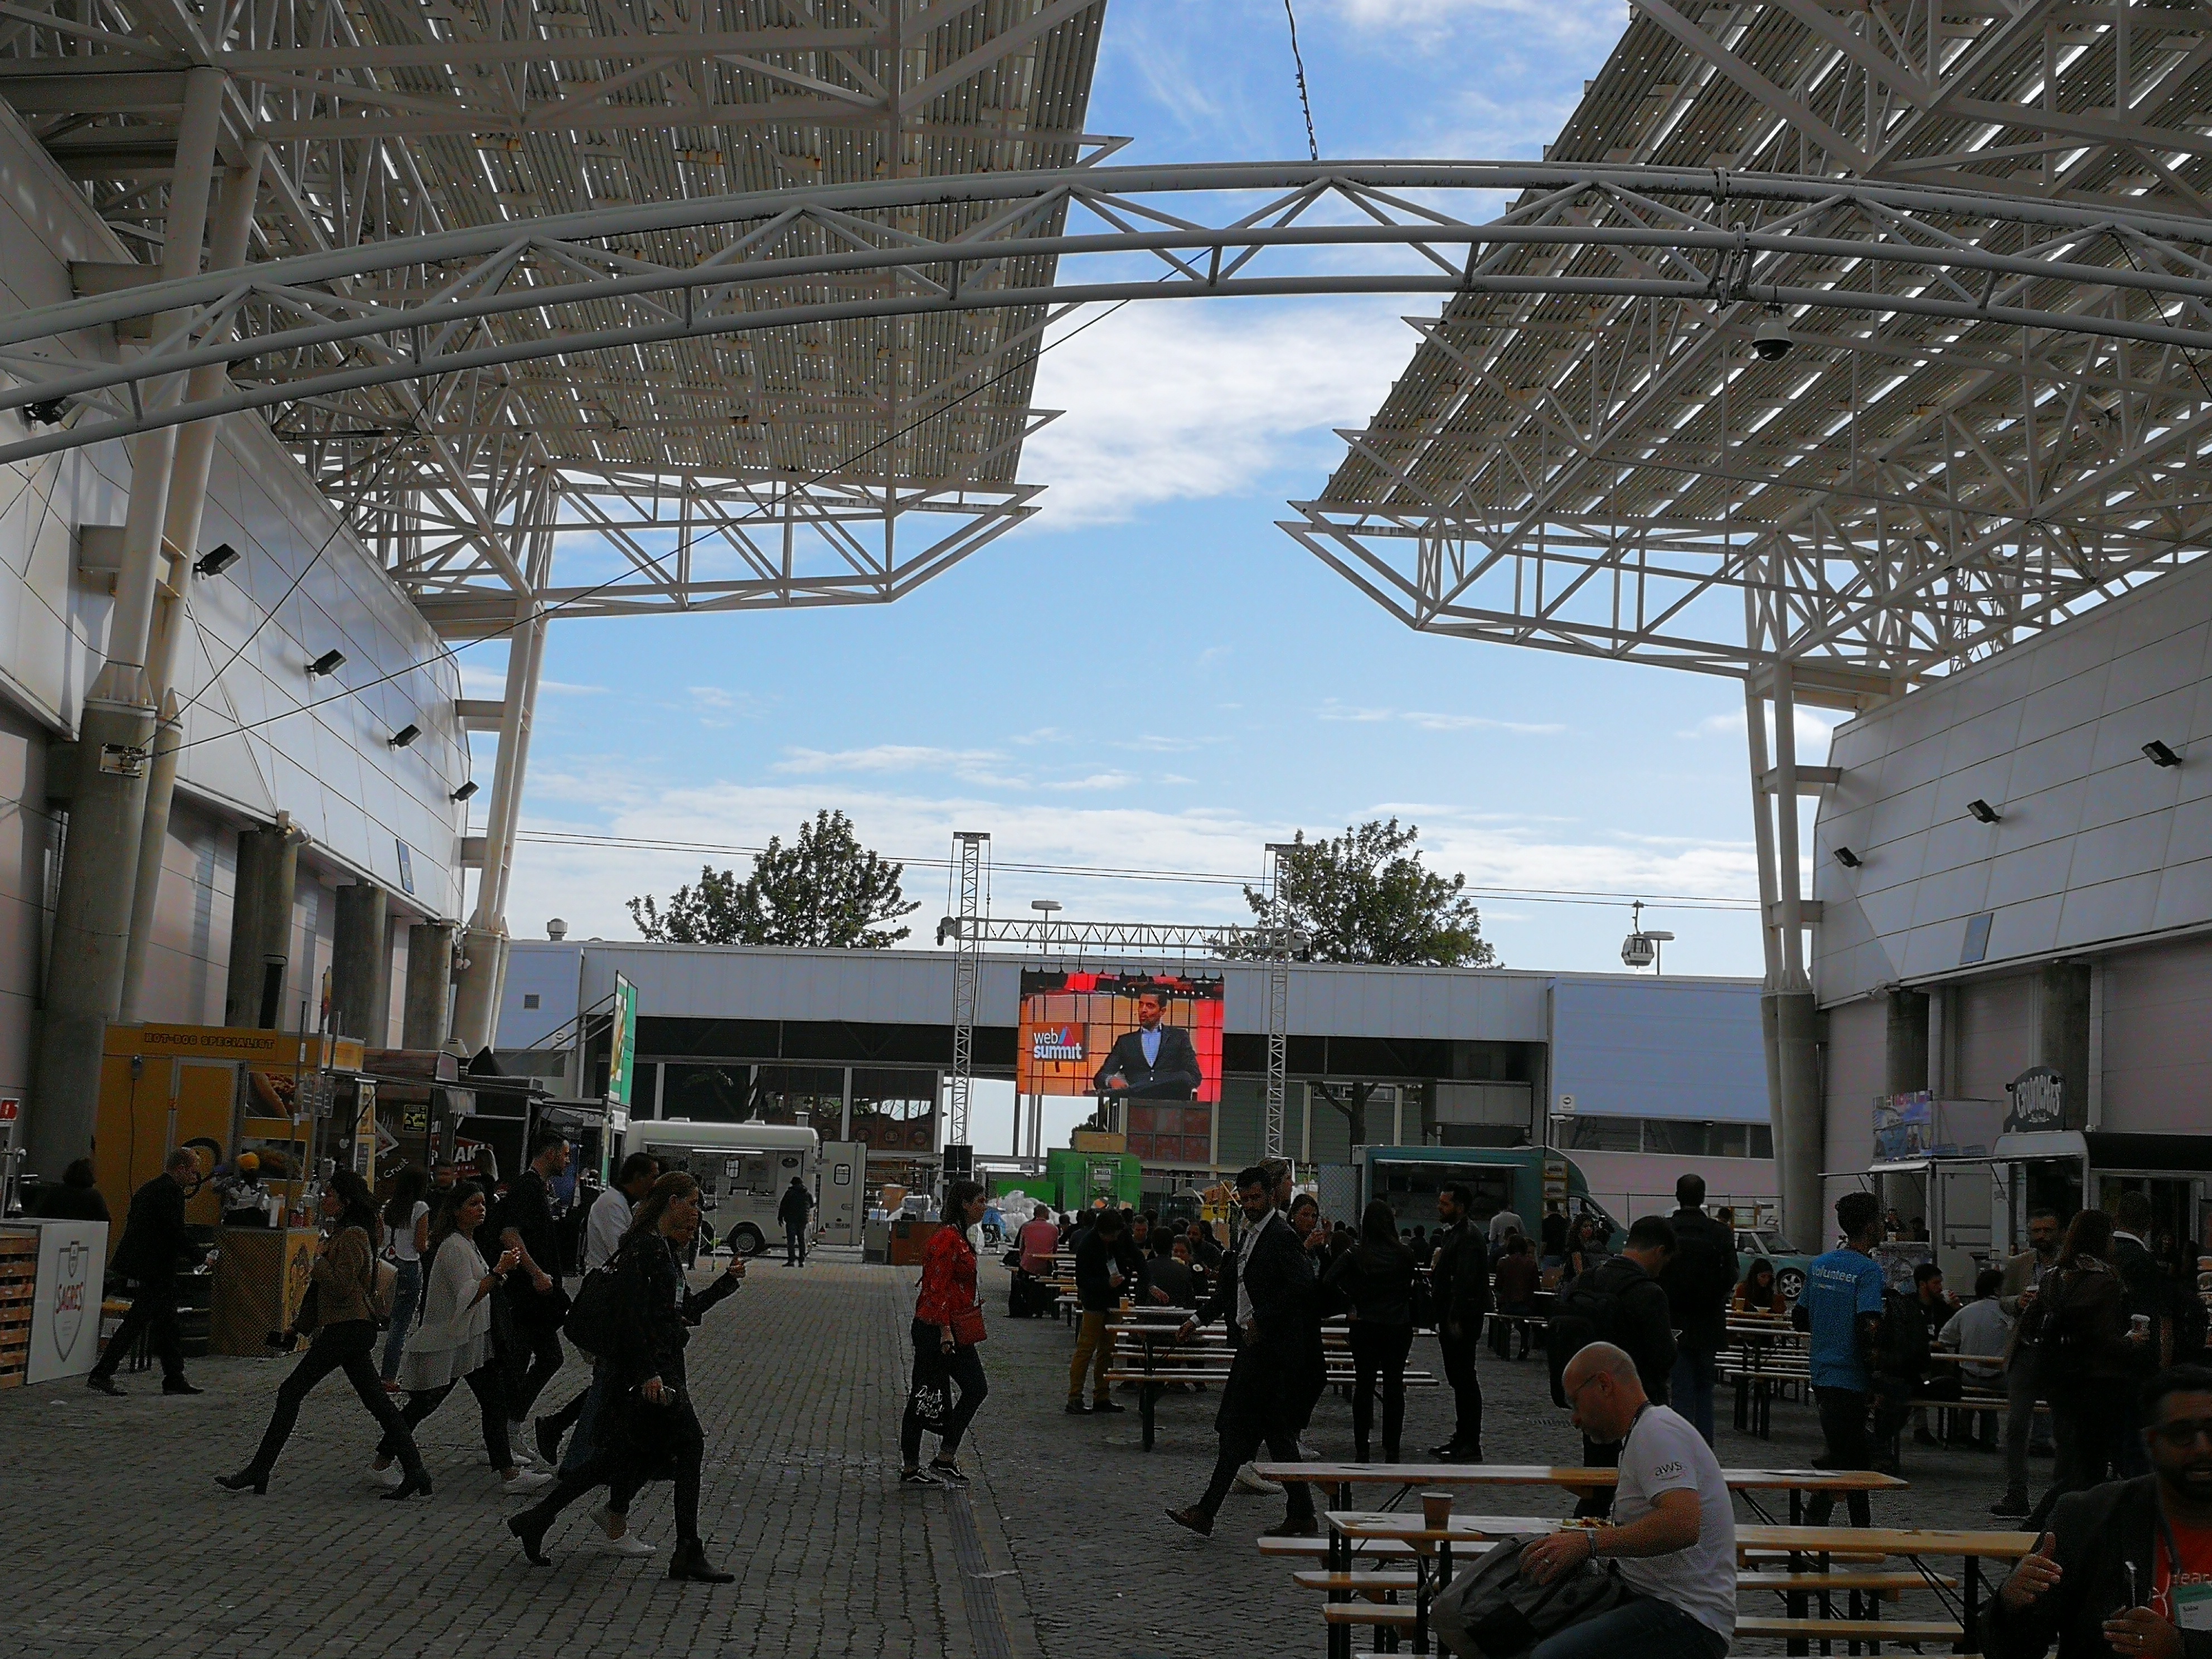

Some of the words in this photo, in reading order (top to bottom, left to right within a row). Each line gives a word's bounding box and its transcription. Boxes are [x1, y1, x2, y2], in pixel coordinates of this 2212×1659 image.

[144, 1032, 197, 1045] HOT-DOG
[201, 1036, 275, 1049] SPECIALIST
[1034, 1027, 1058, 1044] web
[1034, 1042, 1082, 1060] summit
[384, 1157, 409, 1178] Crust
[1655, 1462, 1682, 1476] aws
